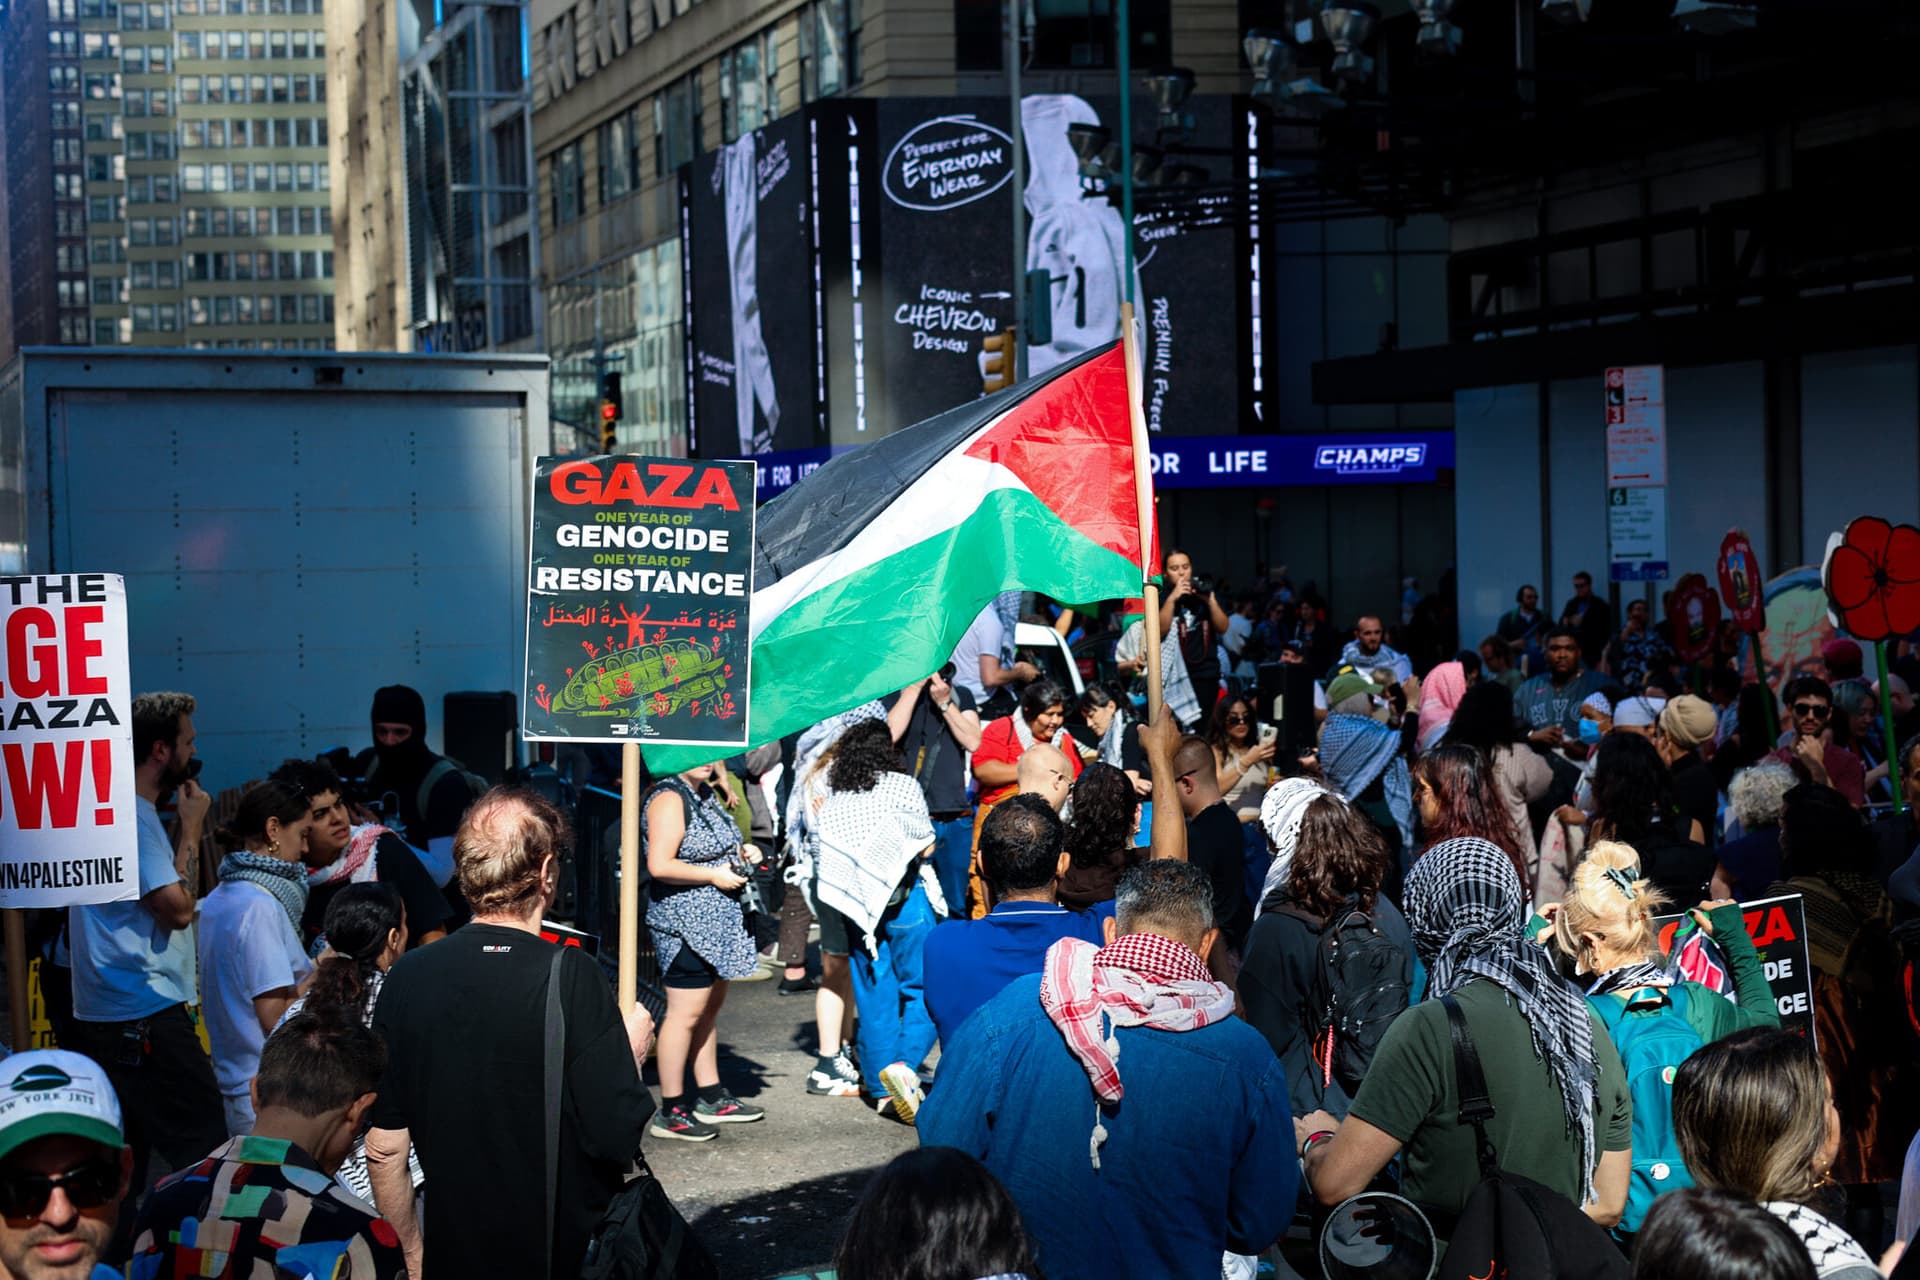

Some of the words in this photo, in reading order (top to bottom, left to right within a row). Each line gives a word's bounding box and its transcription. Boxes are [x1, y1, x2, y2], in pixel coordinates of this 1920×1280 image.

[902, 147, 1002, 189] EVERYDAY
[930, 174, 986, 199] WEAR
[920, 283, 973, 303] ICONIC
[894, 303, 996, 332] CHEVRON
[913, 331, 969, 353] DESIGN
[1150, 452, 1181, 474] OR
[1208, 450, 1268, 473] LIFE
[1319, 447, 1421, 465] CHAMPS
[550, 461, 740, 511] GAZA
[772, 465, 792, 486] FOR
[594, 511, 627, 523] ONE
[627, 512, 670, 524] YEAR
[671, 514, 693, 526] OF
[556, 524, 729, 552] GENOCIDE
[593, 553, 626, 565] ONE
[626, 554, 669, 567] YEAR
[670, 556, 691, 567] OF
[0, 574, 107, 605] THE
[536, 566, 745, 596] RESISTANCE
[0, 605, 108, 699] GE
[0, 698, 120, 731] AZA
[0, 739, 114, 830] W!
[1760, 958, 1793, 982] DE
[1774, 992, 1808, 1015] CE
[24, 1092, 61, 1104] YORK
[69, 1092, 95, 1105] JETS
